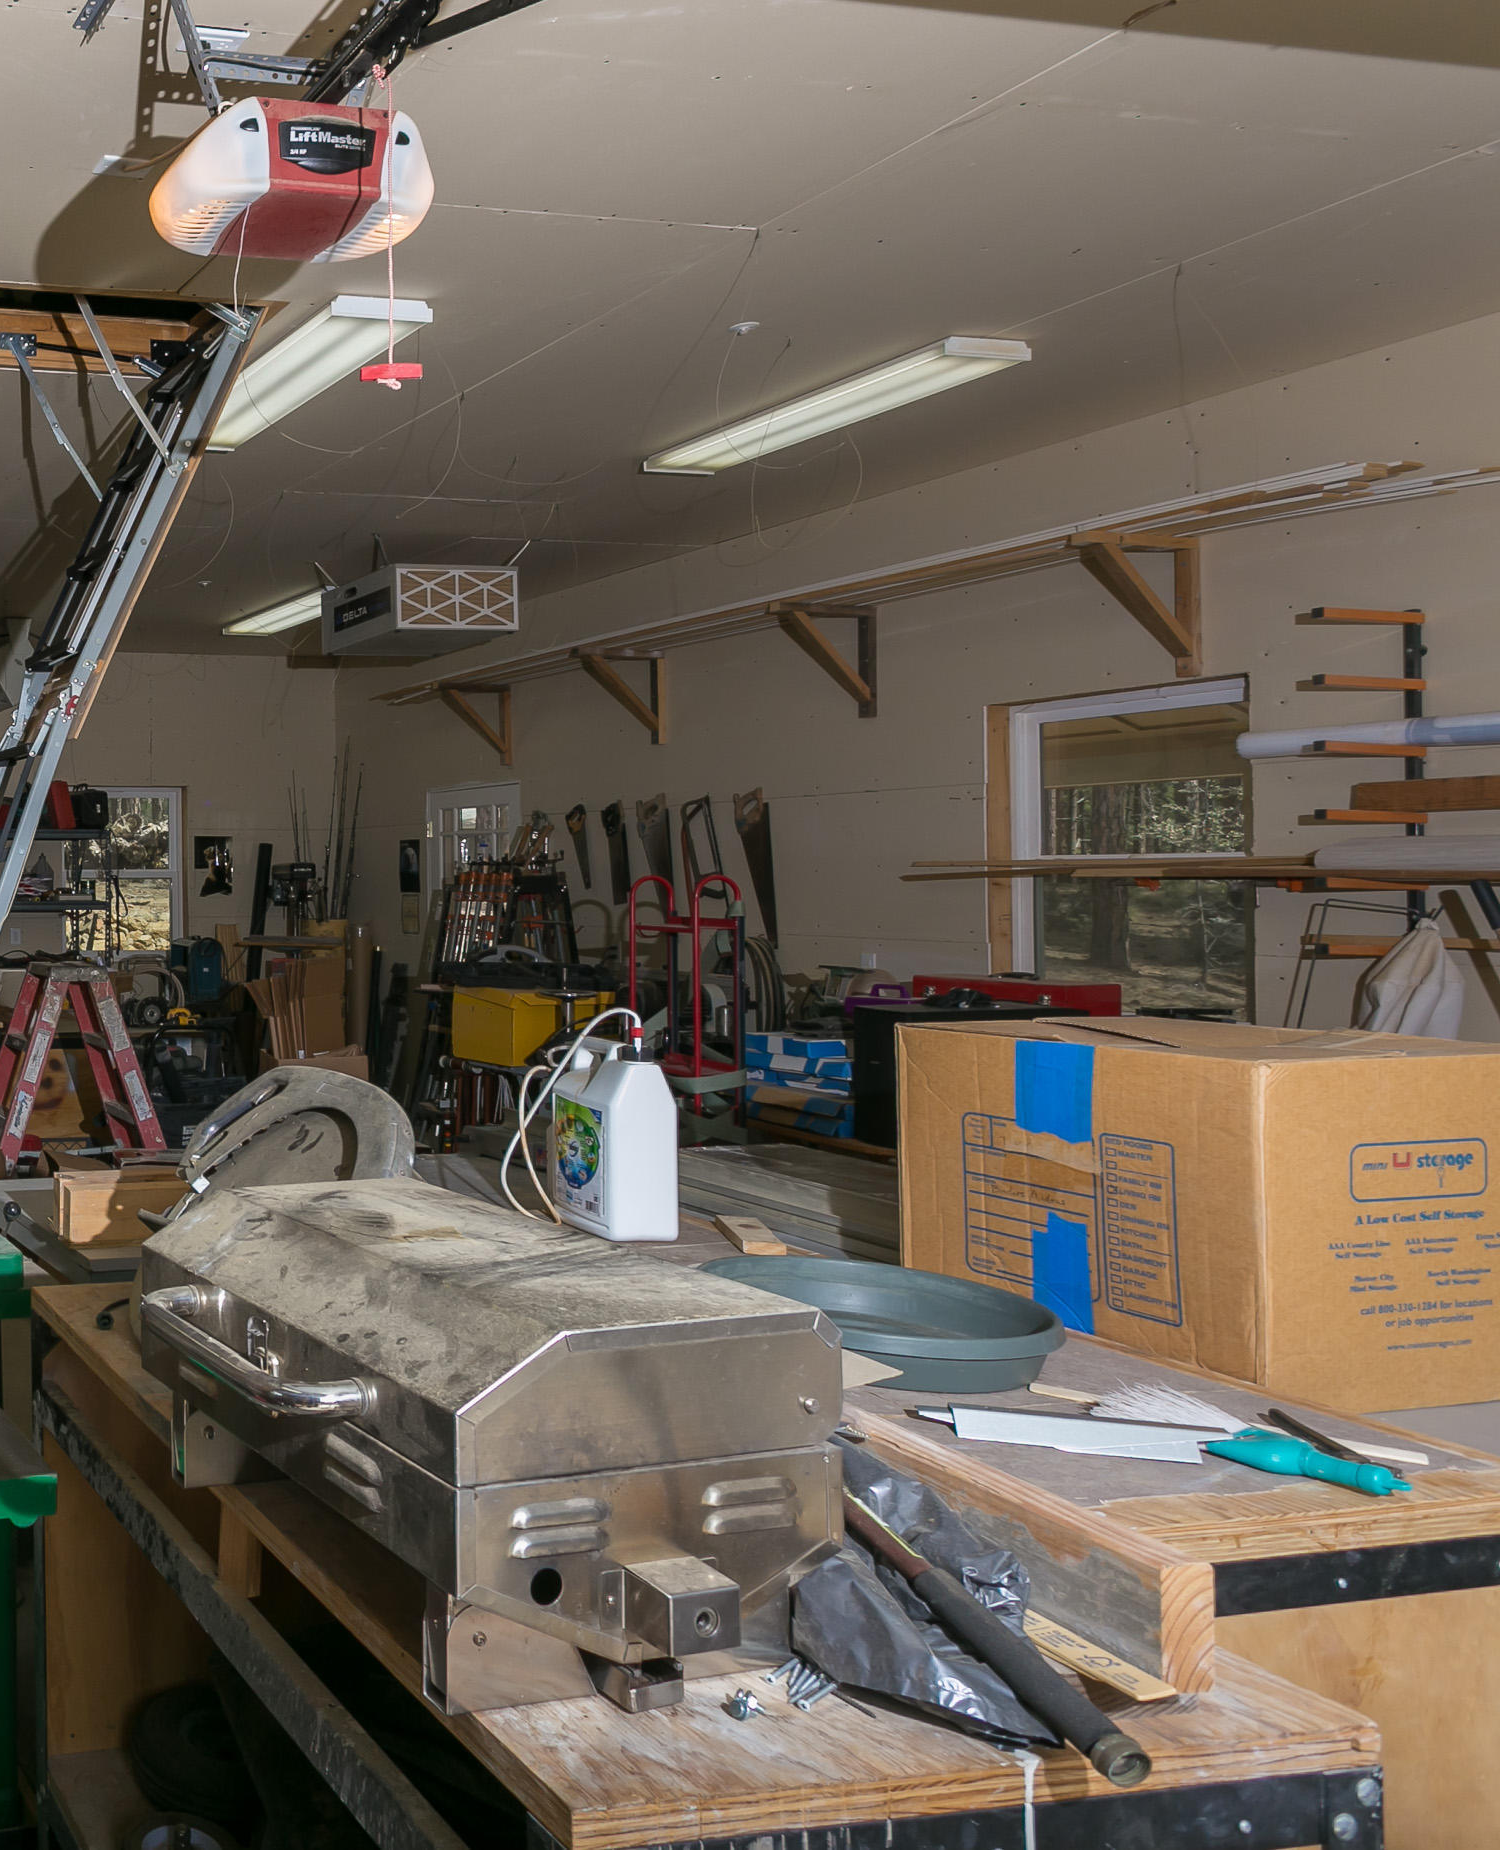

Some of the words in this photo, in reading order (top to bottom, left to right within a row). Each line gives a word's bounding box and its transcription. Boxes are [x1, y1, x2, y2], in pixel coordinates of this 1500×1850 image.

[290, 131, 366, 145] LiftMaster
[342, 606, 368, 622] DELTA
[1362, 1162, 1388, 1171] mini
[1417, 1153, 1474, 1171] storage
[1354, 1215, 1363, 1226] A
[1366, 1214, 1389, 1225] Low
[1392, 1213, 1417, 1223] Cost
[1419, 1211, 1442, 1221] Self
[1443, 1209, 1485, 1221] Storage
[1360, 1306, 1375, 1315] call
[1440, 1300, 1452, 1309] for
[1455, 1299, 1493, 1308] locations
[1398, 1317, 1412, 1328] job
[1415, 1315, 1474, 1327] opportunities
